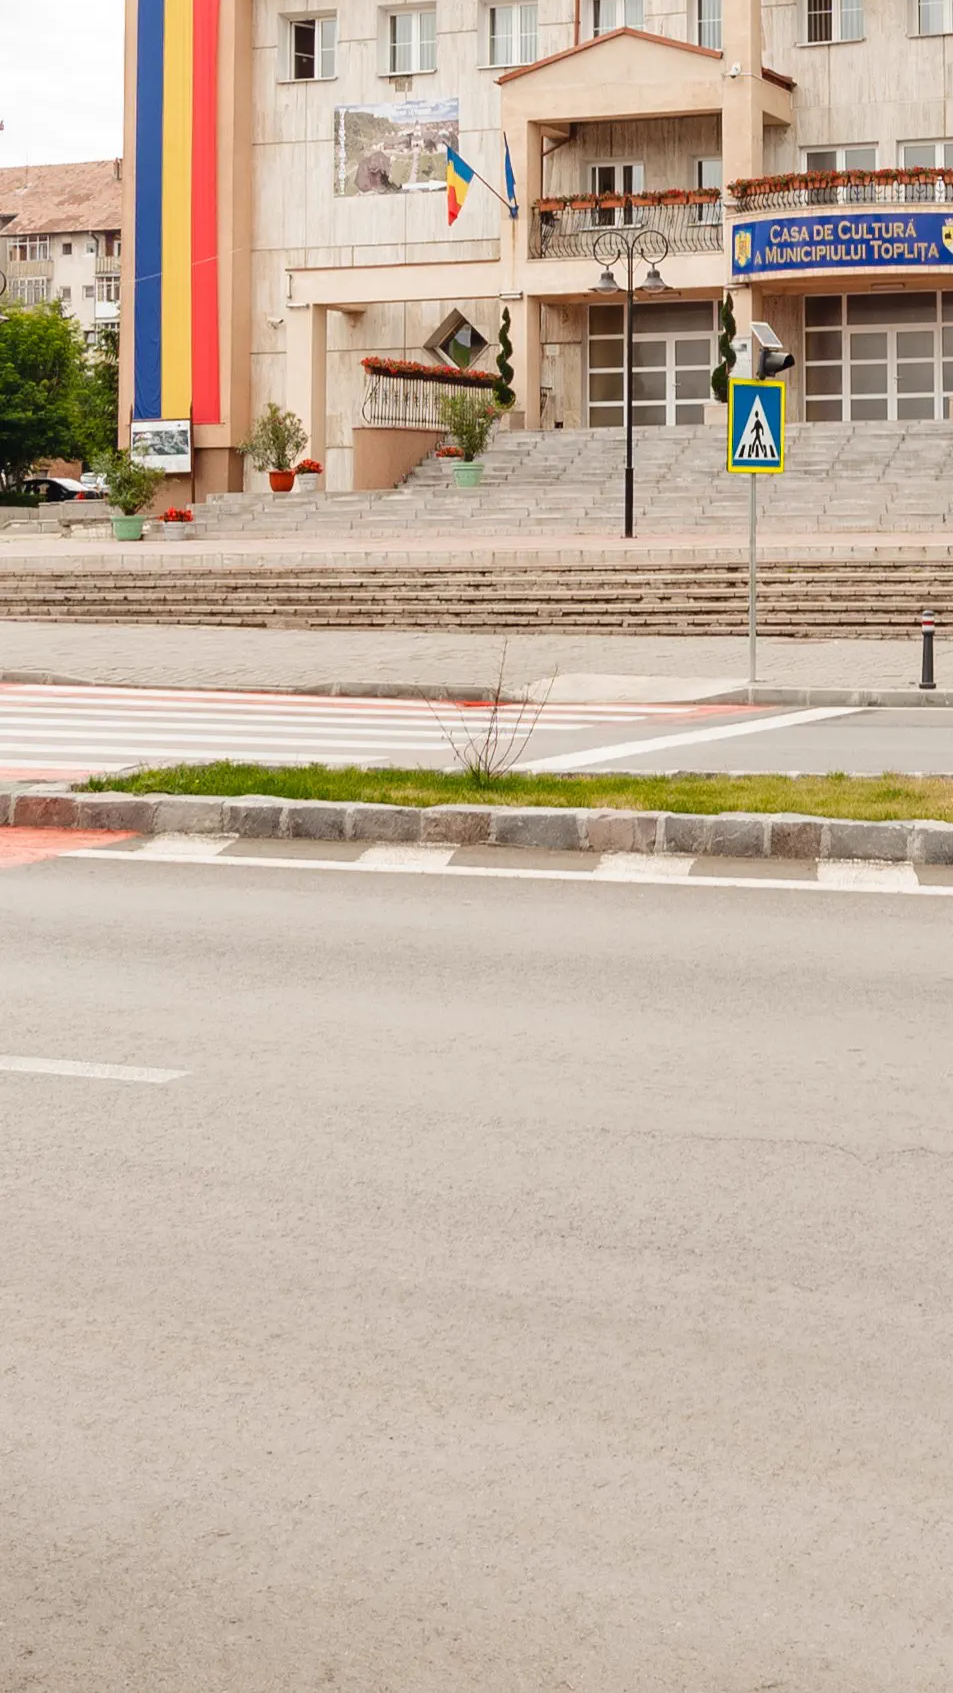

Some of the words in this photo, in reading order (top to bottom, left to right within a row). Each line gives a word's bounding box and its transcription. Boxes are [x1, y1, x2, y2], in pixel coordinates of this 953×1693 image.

[769, 225, 810, 244] CASA
[813, 224, 834, 241] DE
[754, 250, 763, 265] A
[765, 243, 867, 265] MUNICIPIULUI
